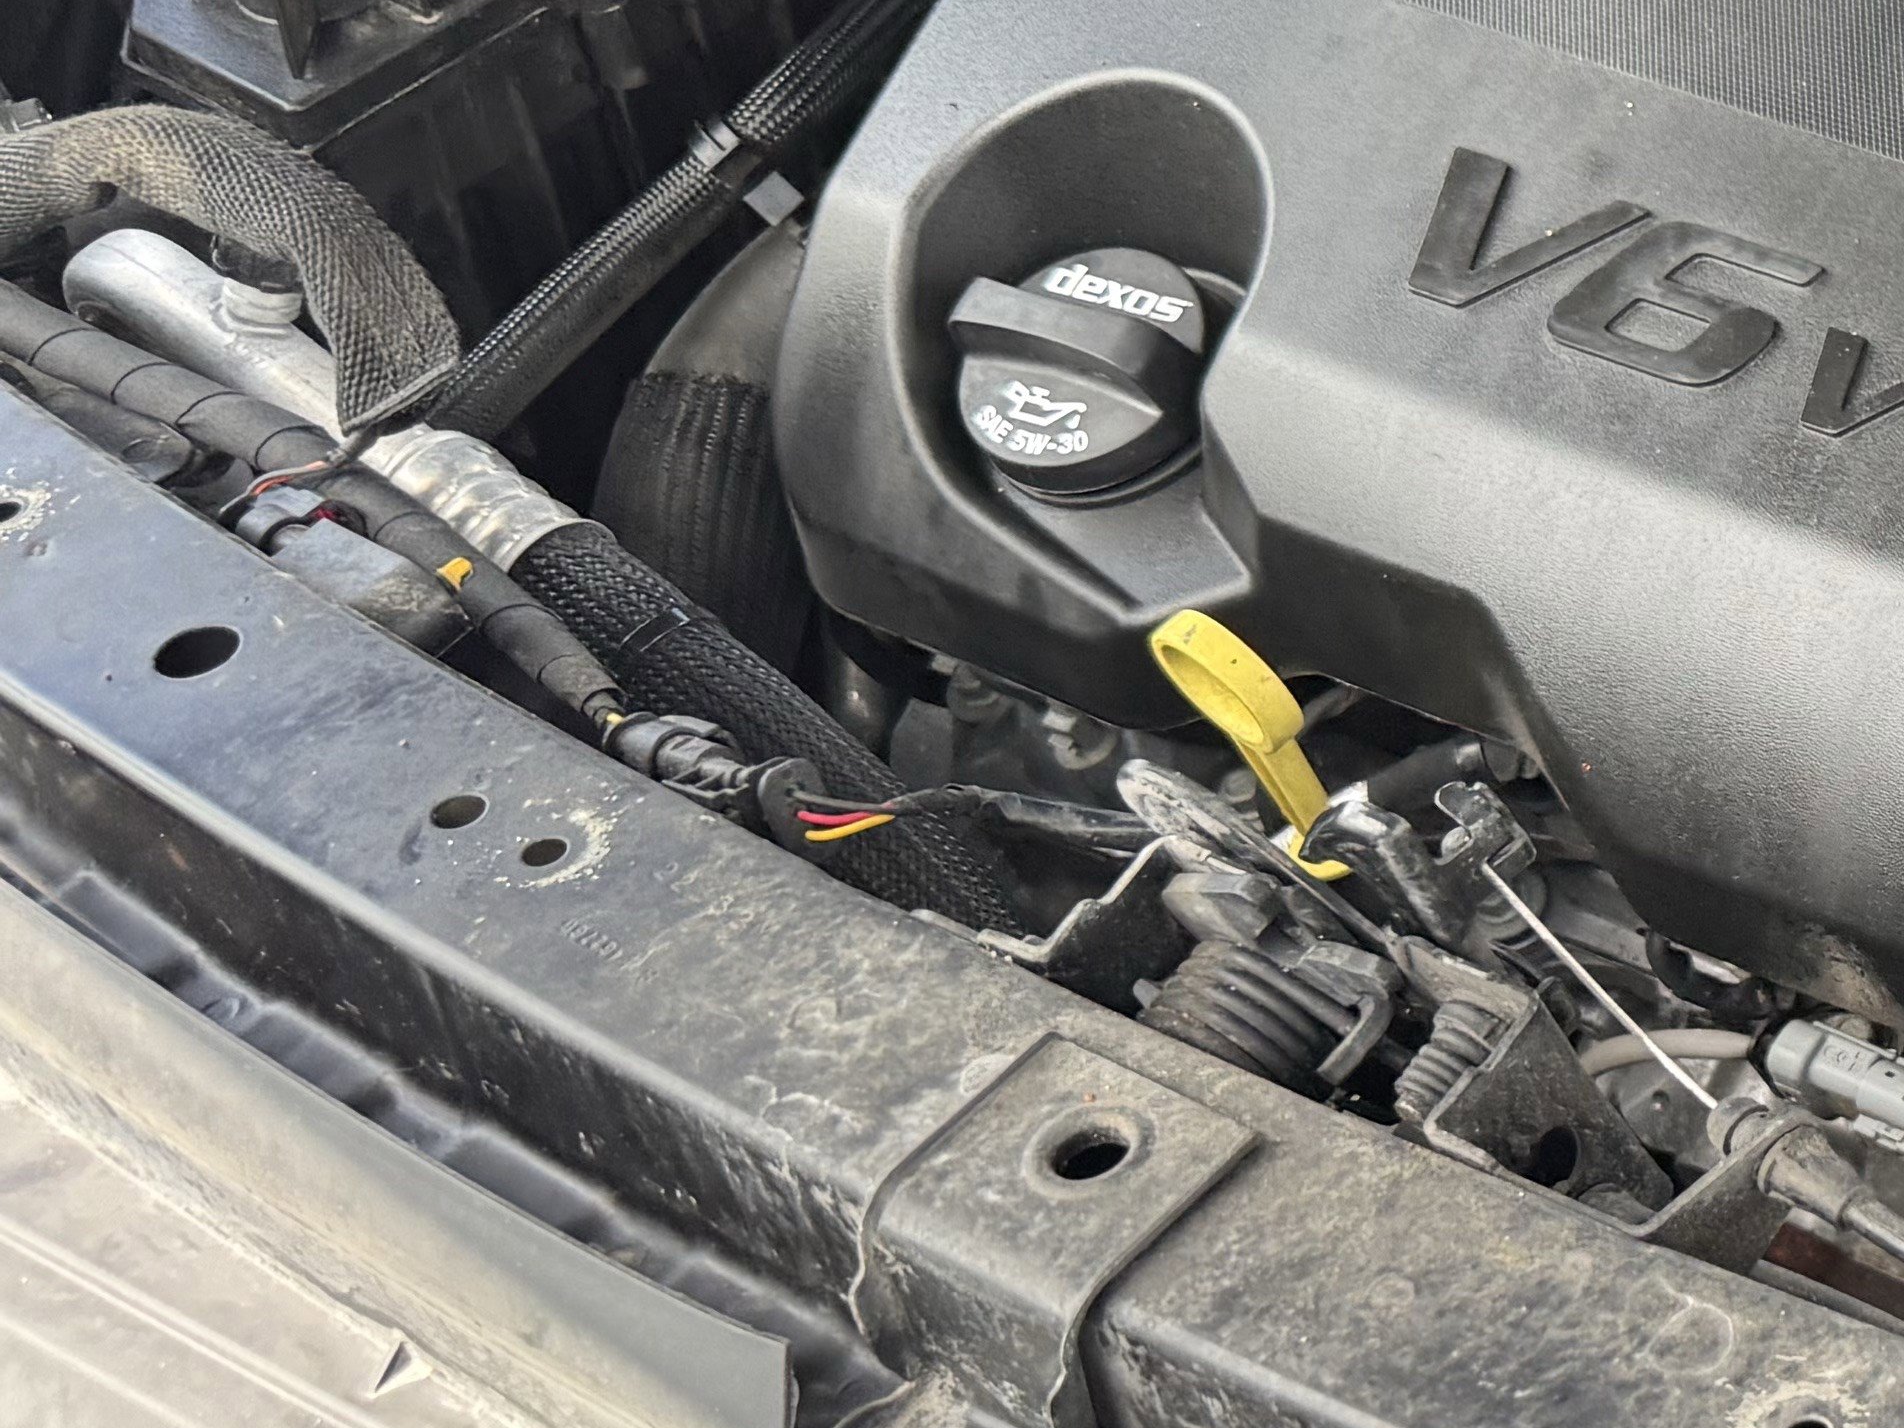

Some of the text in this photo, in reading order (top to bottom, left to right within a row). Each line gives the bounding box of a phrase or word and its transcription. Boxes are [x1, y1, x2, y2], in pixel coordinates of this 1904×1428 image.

[1044, 264, 1194, 323] dexos
[1408, 146, 1826, 388] V6
[975, 404, 1089, 456] SAE 5W-30
